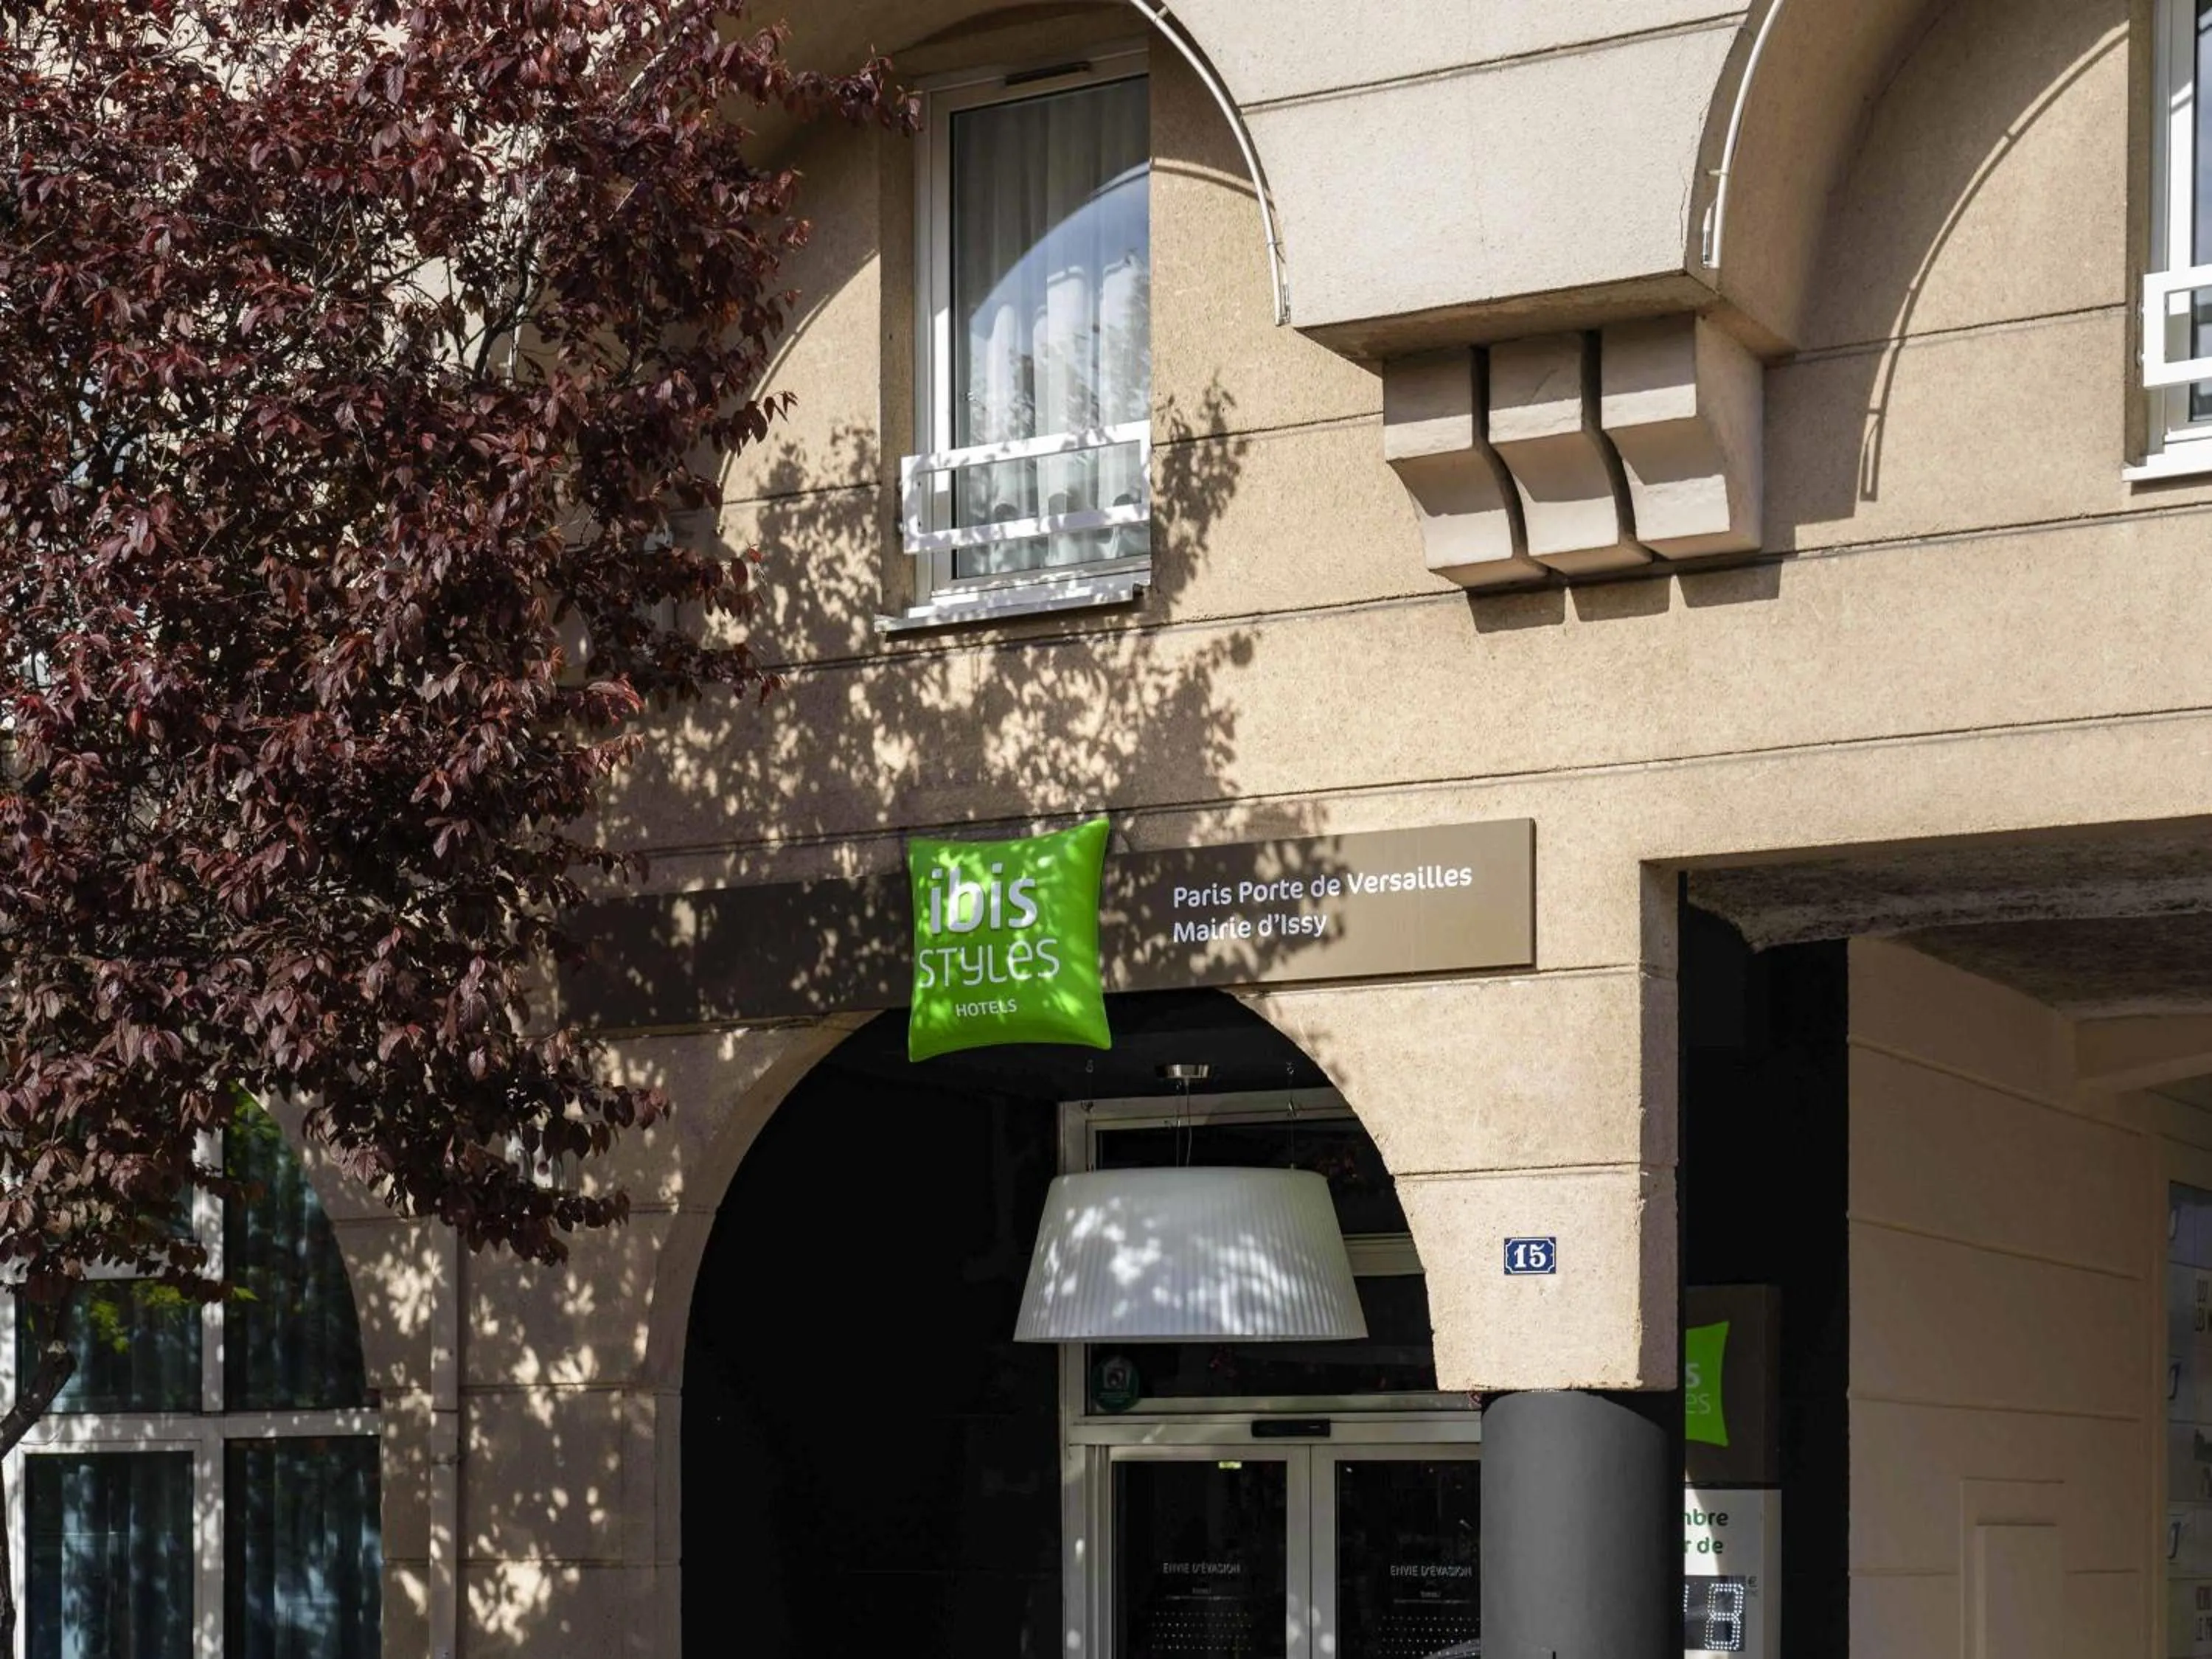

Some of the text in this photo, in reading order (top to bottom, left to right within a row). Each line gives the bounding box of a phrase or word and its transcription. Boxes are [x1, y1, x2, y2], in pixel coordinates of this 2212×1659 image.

[931, 862, 1038, 934] ibis
[1173, 865, 1473, 908] Paris Porte de Versailles
[1173, 914, 1327, 943] Mairie d'Issy
[956, 998, 1018, 1017] HOTELS
[1514, 1243, 1546, 1267] 15
[1697, 1537, 1724, 1554] de
